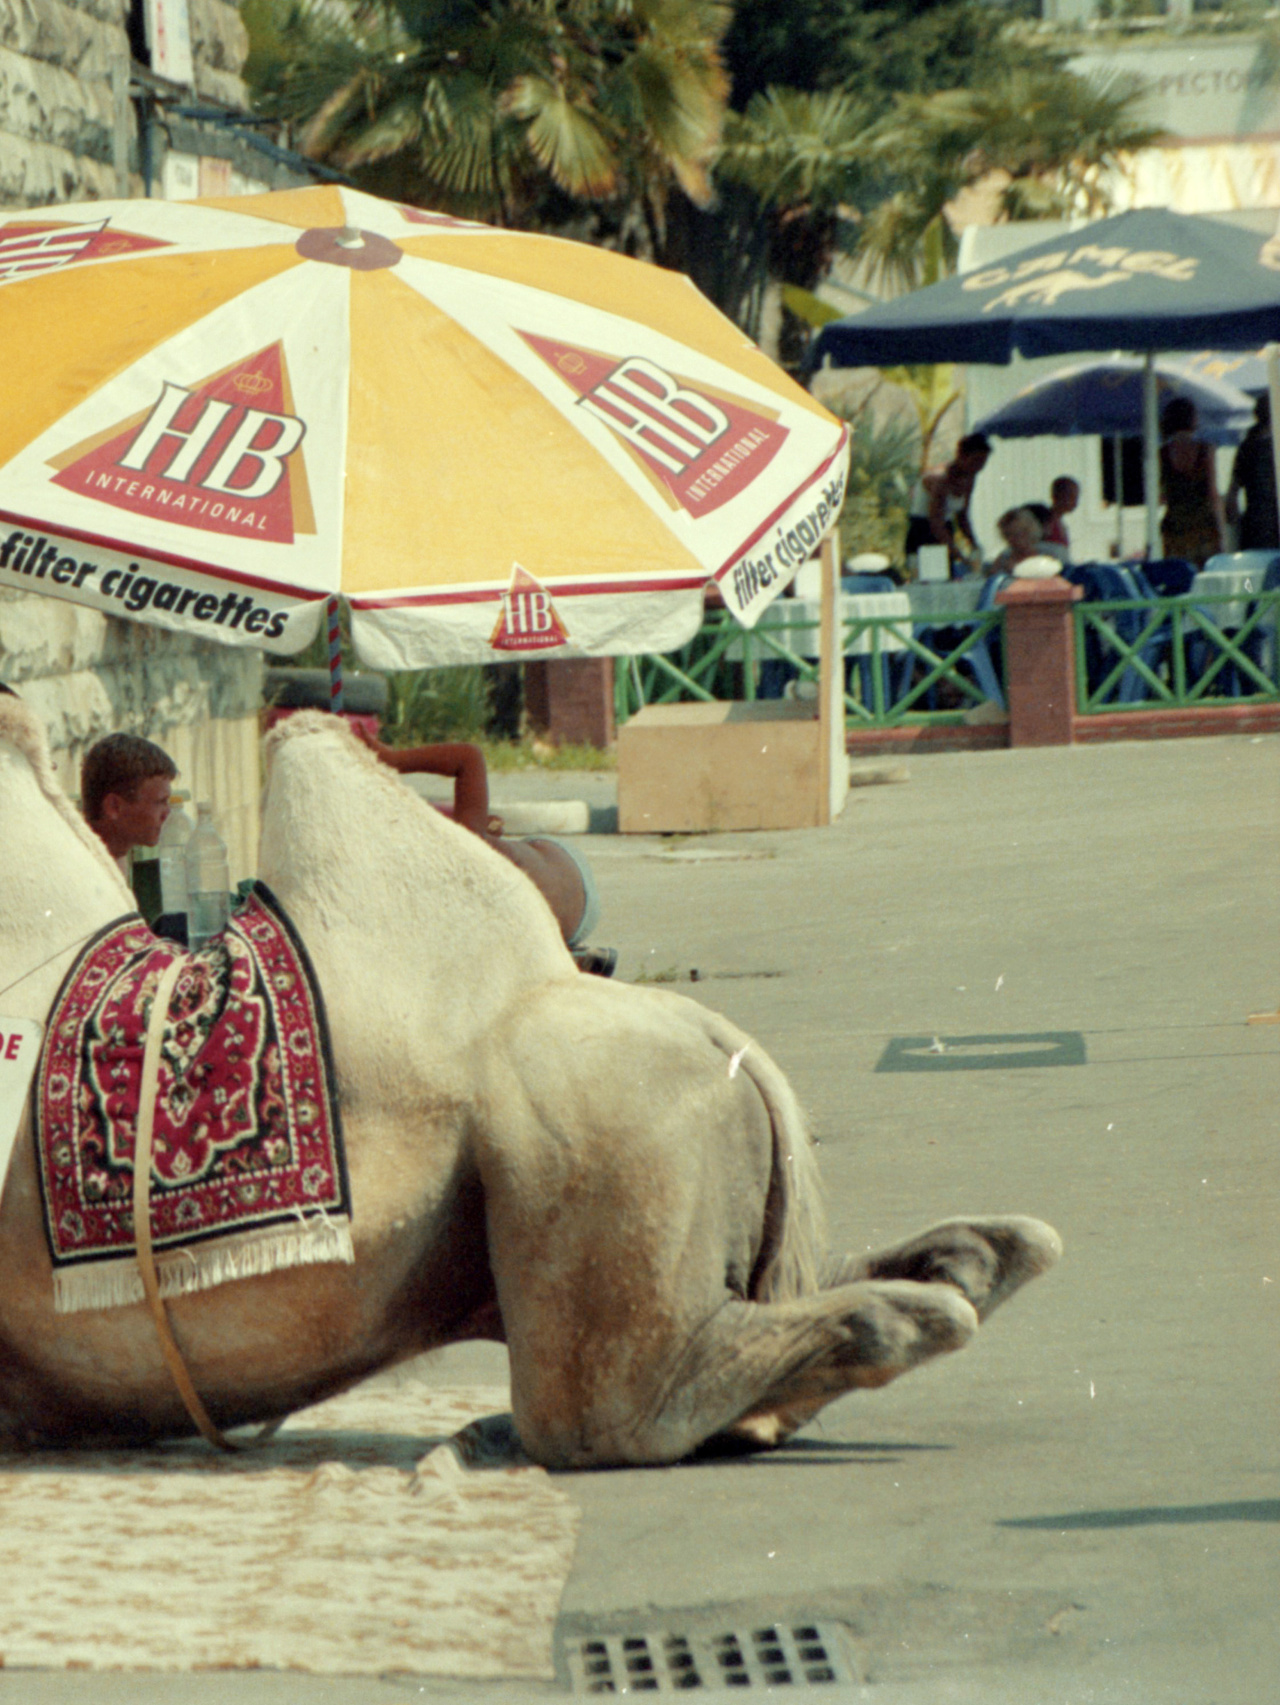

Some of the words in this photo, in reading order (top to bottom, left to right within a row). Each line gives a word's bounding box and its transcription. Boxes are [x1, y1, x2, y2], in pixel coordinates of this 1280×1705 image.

[120, 381, 307, 500] HB
[576, 356, 732, 476] HB
[85, 470, 268, 532] INTERNATIONAL
[684, 426, 771, 502] INTERNATIONAL
[100, 562, 290, 638] cigarettes
[499, 592, 554, 636] HB
[733, 558, 778, 611] filter
